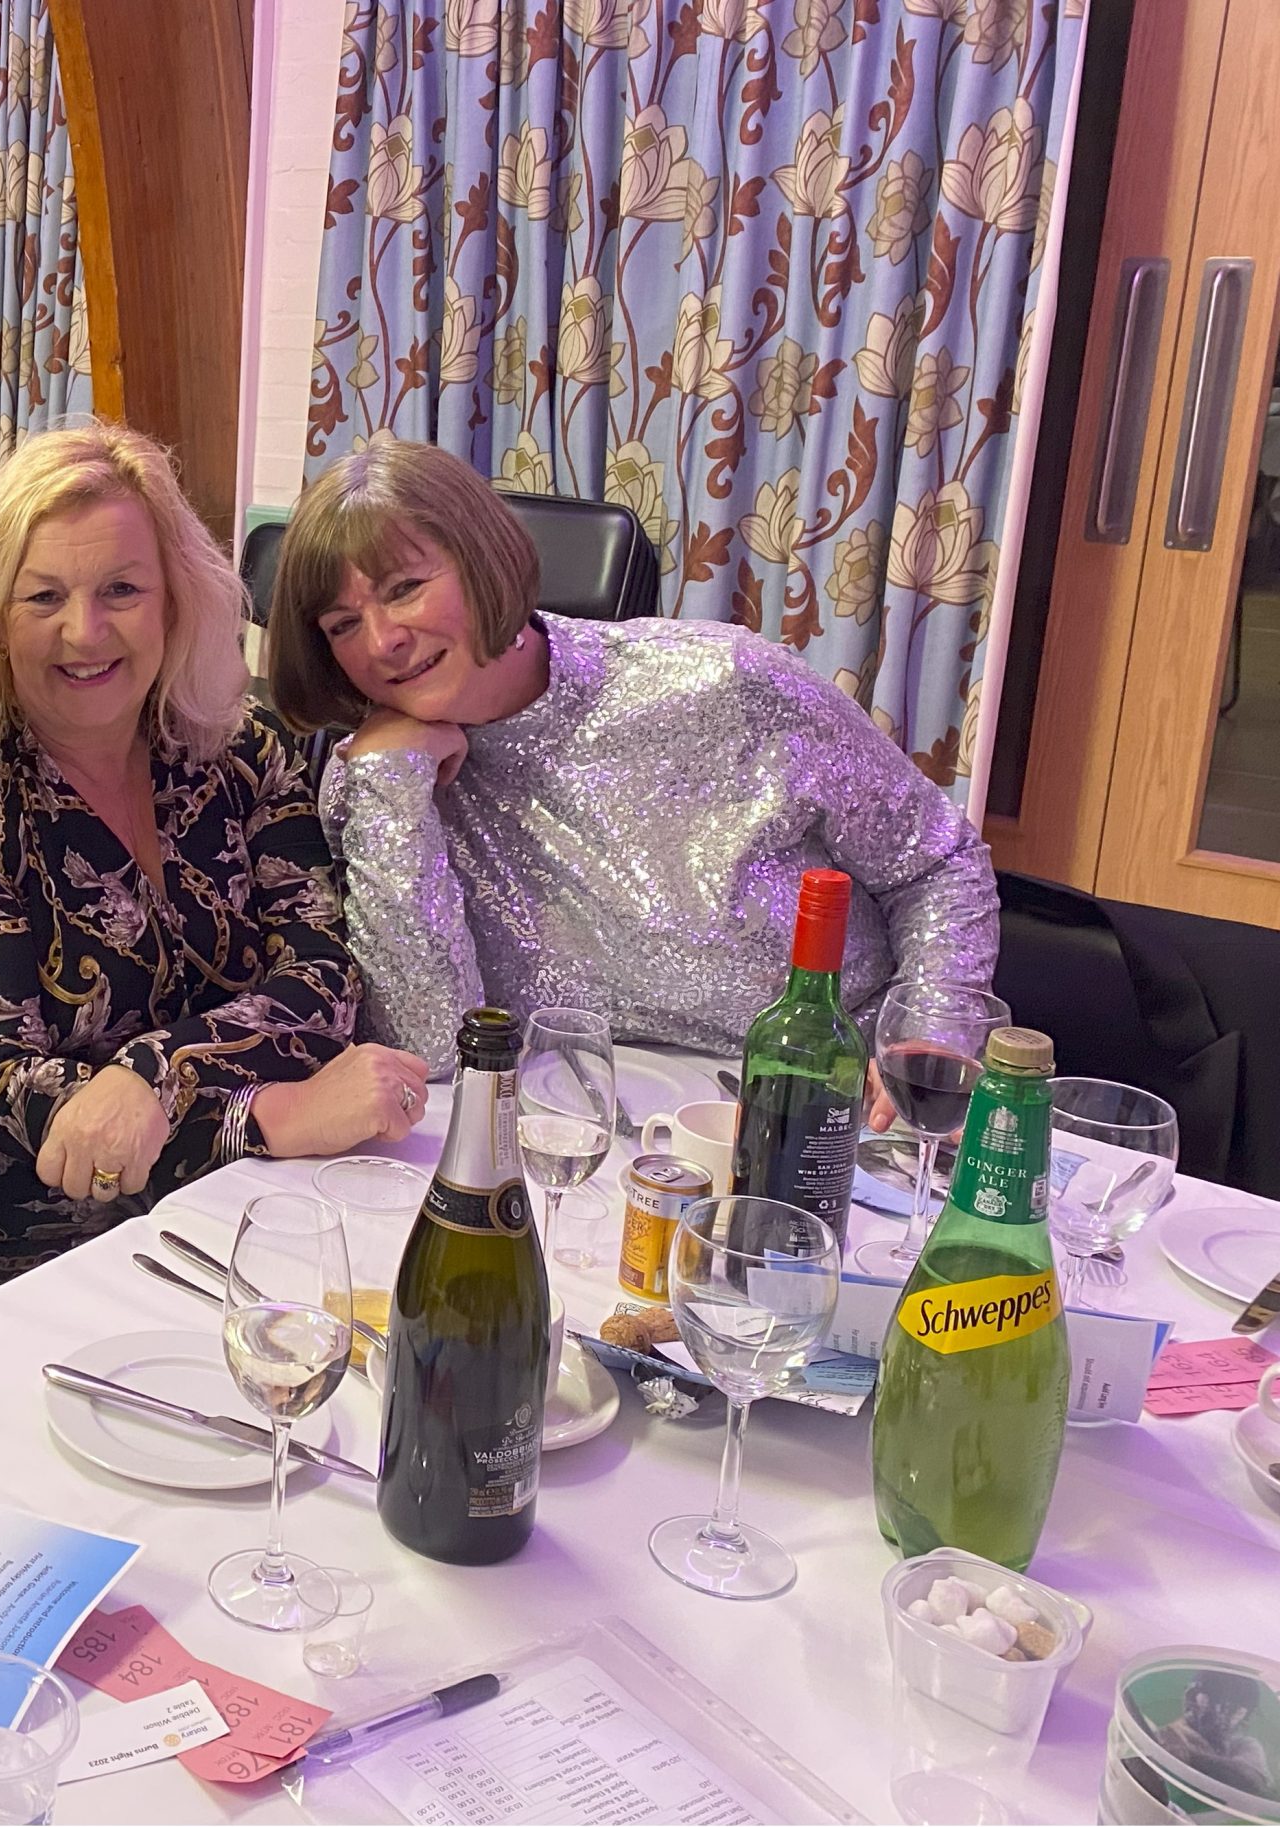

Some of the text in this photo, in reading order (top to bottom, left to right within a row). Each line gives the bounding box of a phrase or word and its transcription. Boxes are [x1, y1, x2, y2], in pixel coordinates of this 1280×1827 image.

[820, 1124, 854, 1133] MALBEC
[967, 1156, 1028, 1179] GINGER
[978, 1173, 1009, 1188] ALE
[917, 1280, 1051, 1337] Schweppes
[474, 1441, 537, 1459] VALDOBBIA
[477, 1453, 520, 1464] PROSECCO
[10, 1552, 43, 1582] First Whisky
[51, 1580, 78, 1605] Welcome
[16, 1601, 40, 1624] Annette
[41, 1605, 54, 1617] and
[72, 1629, 117, 1664] 185
[118, 1653, 163, 1687] 184
[165, 1699, 196, 1714] Table 2
[172, 1706, 201, 1721] Debbie
[142, 1717, 173, 1731] Wilson
[181, 1724, 209, 1739] Rotary
[268, 1714, 314, 1746] 181
[87, 1743, 160, 1768] Burns Night 2023
[538, 1739, 580, 1760] Lemon Lime
[616, 1752, 634, 1763] Water
[227, 1751, 271, 1781] 76
[561, 1764, 581, 1774] Grape
[565, 1763, 610, 1785] Summer Fruits
[556, 1771, 618, 1802] Apple Watermelon
[570, 1780, 628, 1808] Apple Elderflower
[583, 1788, 638, 1814] Apple Raspberry
[677, 1795, 709, 1811] Lemonade
[680, 1807, 710, 1823] Lemonade
